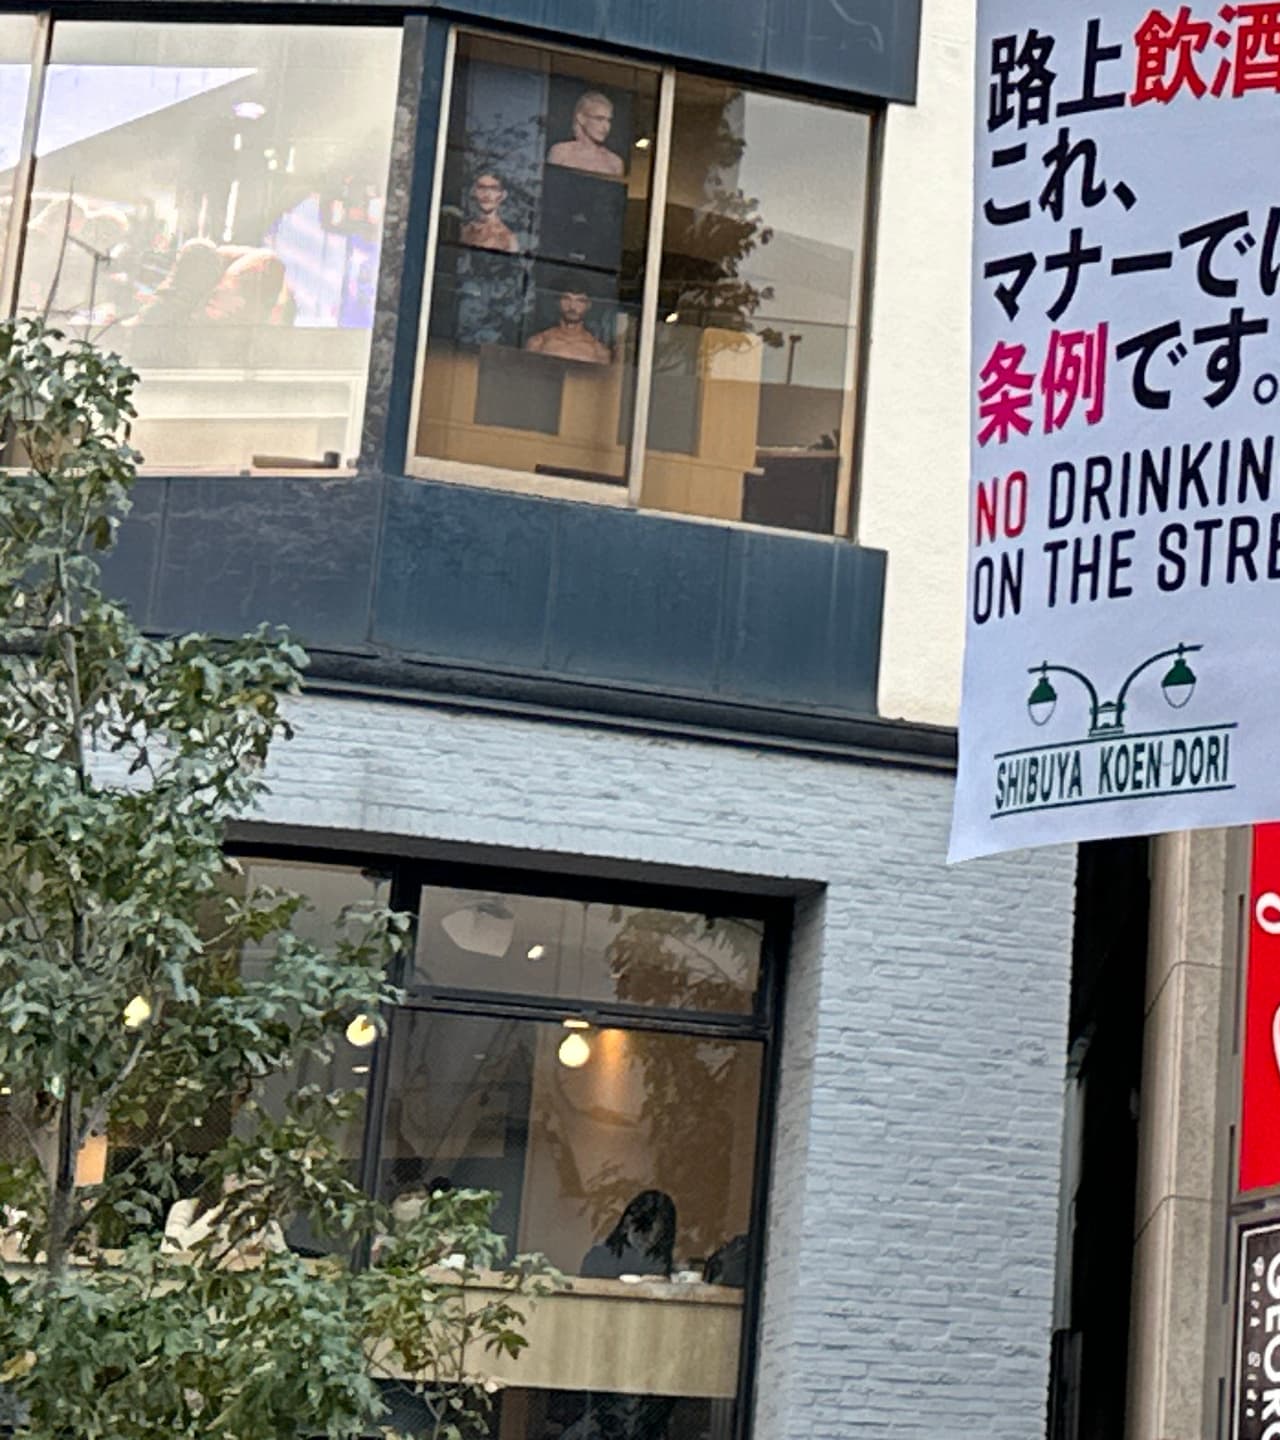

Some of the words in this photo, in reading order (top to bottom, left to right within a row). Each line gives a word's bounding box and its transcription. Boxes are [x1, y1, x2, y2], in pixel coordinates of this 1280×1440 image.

[983, 127, 1138, 226] これ、
[977, 307, 1279, 447] 条例です。
[975, 470, 1028, 547] NO
[973, 548, 1024, 625] ON
[1043, 529, 1136, 607] THE
[995, 748, 1083, 810] SHIBUYA
